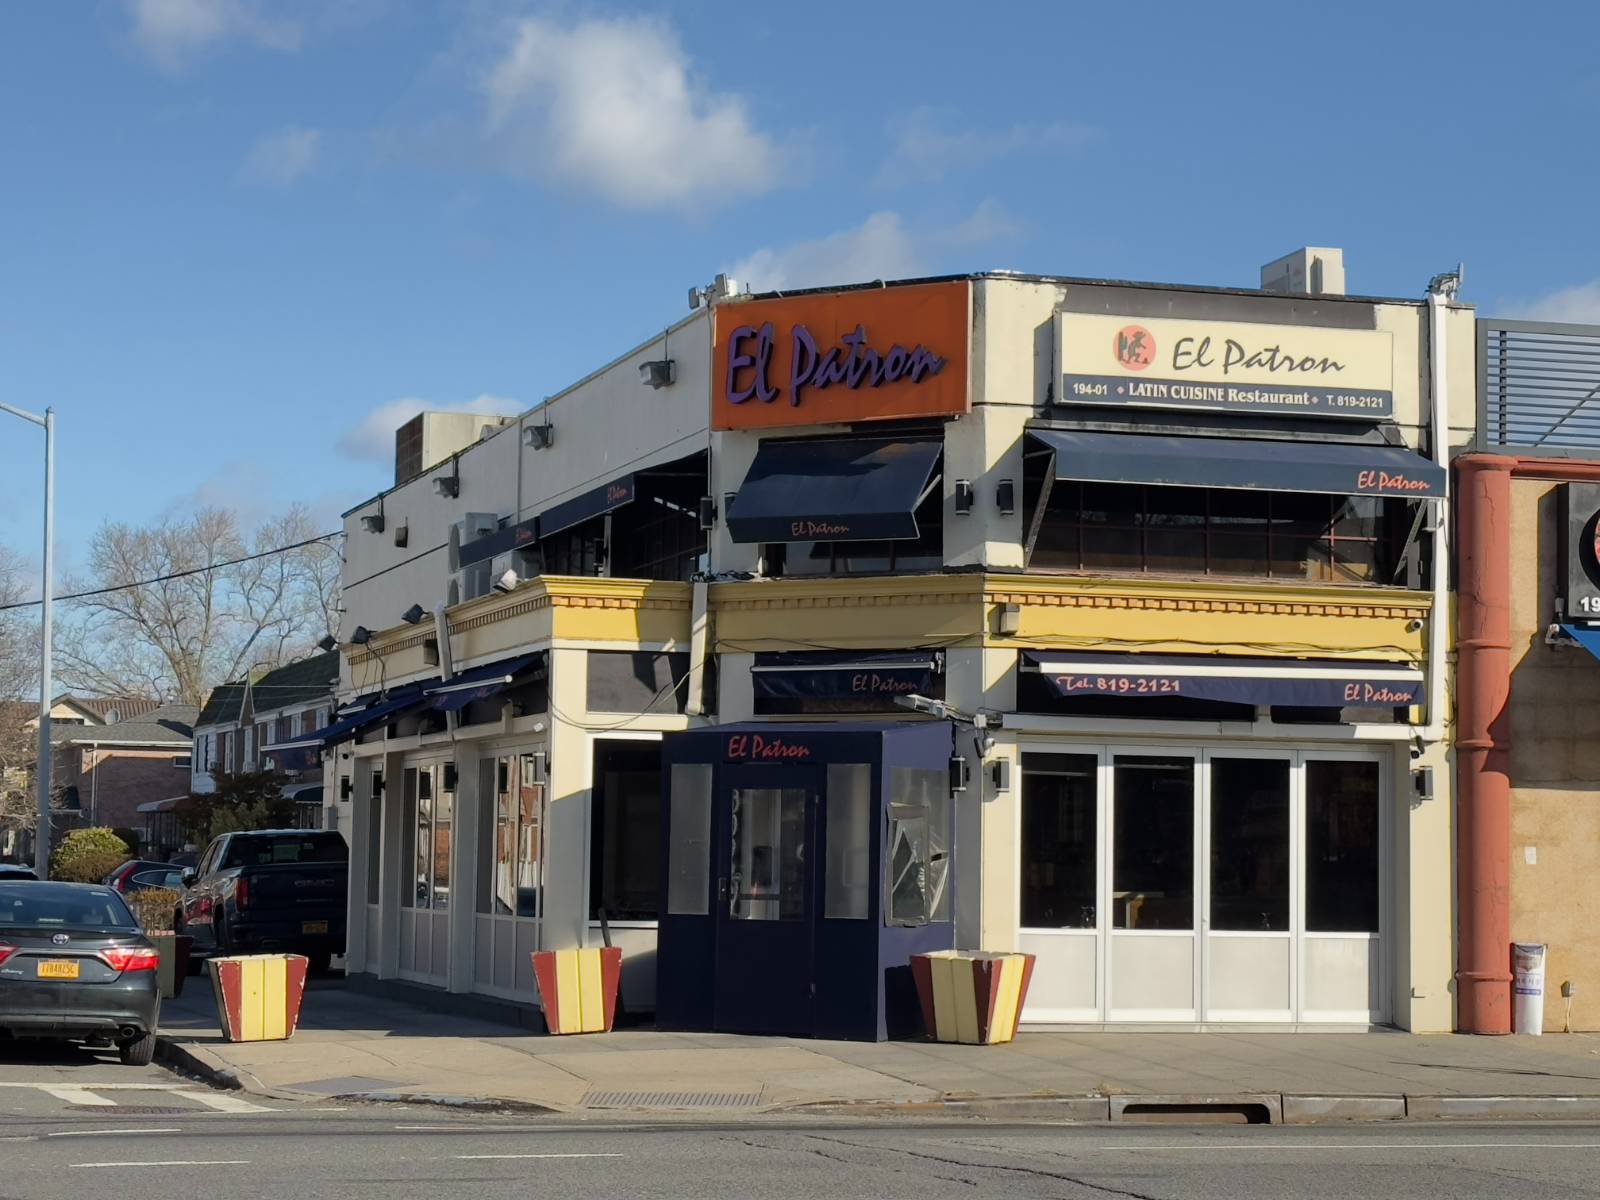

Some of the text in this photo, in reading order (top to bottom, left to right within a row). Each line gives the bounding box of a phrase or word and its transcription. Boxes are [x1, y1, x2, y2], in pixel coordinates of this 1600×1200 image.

[727, 322, 946, 407] El Patron
[1173, 336, 1345, 374] El Patron
[1072, 383, 1108, 396] 194-01
[1129, 382, 1168, 398] LATIN
[1171, 385, 1225, 401] CUISINE
[1228, 388, 1310, 405] Restaurant
[1358, 470, 1430, 491] El Patron
[852, 674, 917, 692] El Patron
[1056, 676, 1181, 694] Tel. 819-2121
[1344, 683, 1412, 702] El Patron
[728, 735, 809, 758] El Patron
